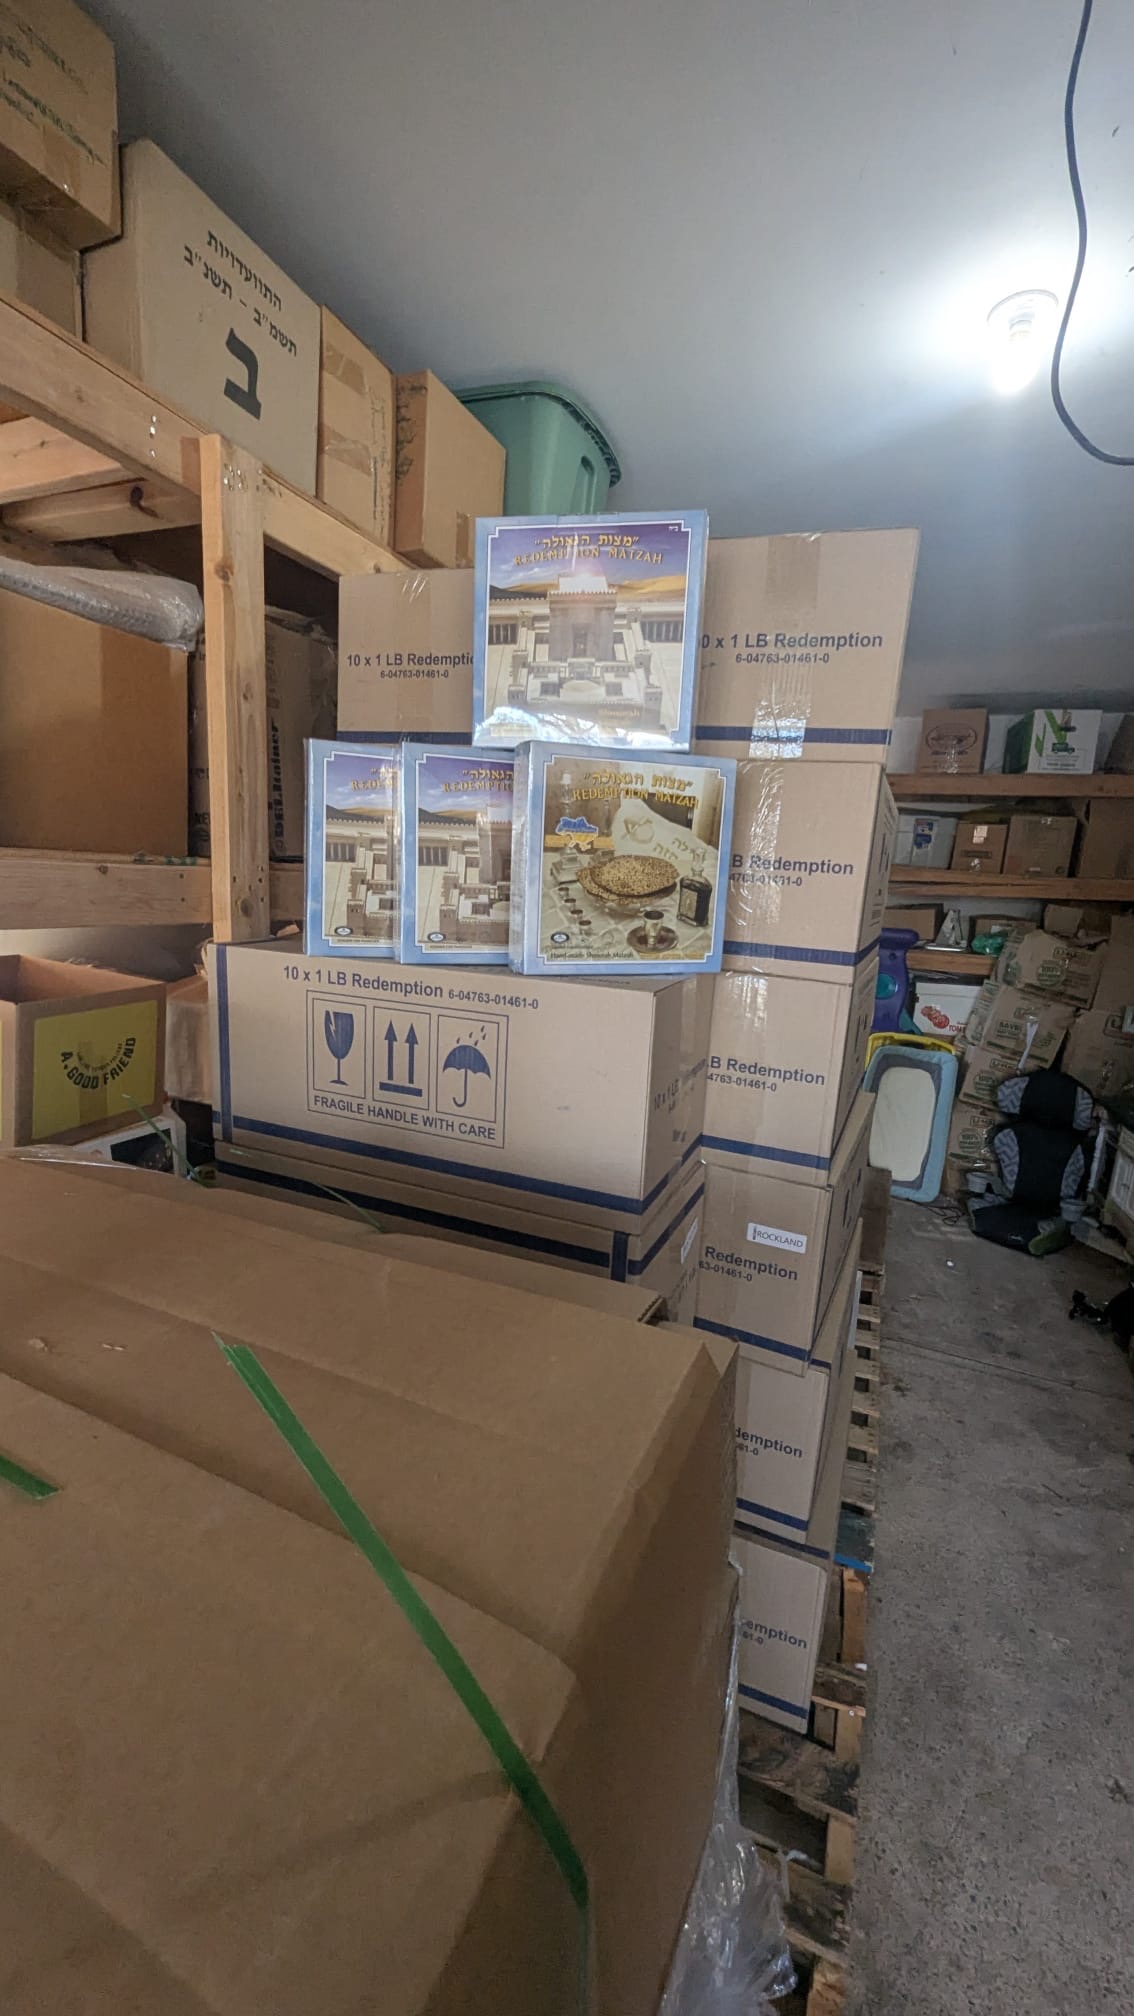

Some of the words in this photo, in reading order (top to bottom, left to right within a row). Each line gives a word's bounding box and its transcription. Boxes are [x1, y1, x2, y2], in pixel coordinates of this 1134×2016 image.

[207, 230, 282, 311] התוועדויות
[223, 327, 262, 420] ב
[608, 546, 663, 565] MATZAH
[701, 634, 711, 649] 0
[715, 636, 724, 649] x
[730, 634, 738, 649] 1
[744, 633, 769, 648] LB
[774, 632, 883, 650] Redemption
[347, 654, 361, 667] 10
[364, 659, 372, 667] x
[376, 654, 382, 667] 1
[386, 653, 403, 666] LB
[735, 653, 831, 665] 6-04763-01461-0
[655, 790, 700, 809] MATZAH
[731, 855, 743, 868] B
[749, 855, 854, 876] Redemption
[283, 965, 299, 981] 10
[303, 972, 312, 982] x
[316, 971, 322, 983] 1
[327, 971, 347, 987] LB
[352, 973, 444, 998] Redemption
[448, 988, 539, 1010] 6-04763-01461-0
[103, 1037, 136, 1086] FRIEND
[709, 1055, 721, 1069] B
[726, 1058, 825, 1086] Redemption
[313, 1095, 364, 1115] FRAGILE
[367, 1106, 419, 1126] HANDLE
[421, 1114, 454, 1133] WITH
[457, 1122, 496, 1141] CARE
[756, 1230, 804, 1248] ROCKLAND
[704, 1246, 798, 1281] Redemption
[735, 1427, 803, 1458] demption
[741, 1619, 807, 1649] emption
